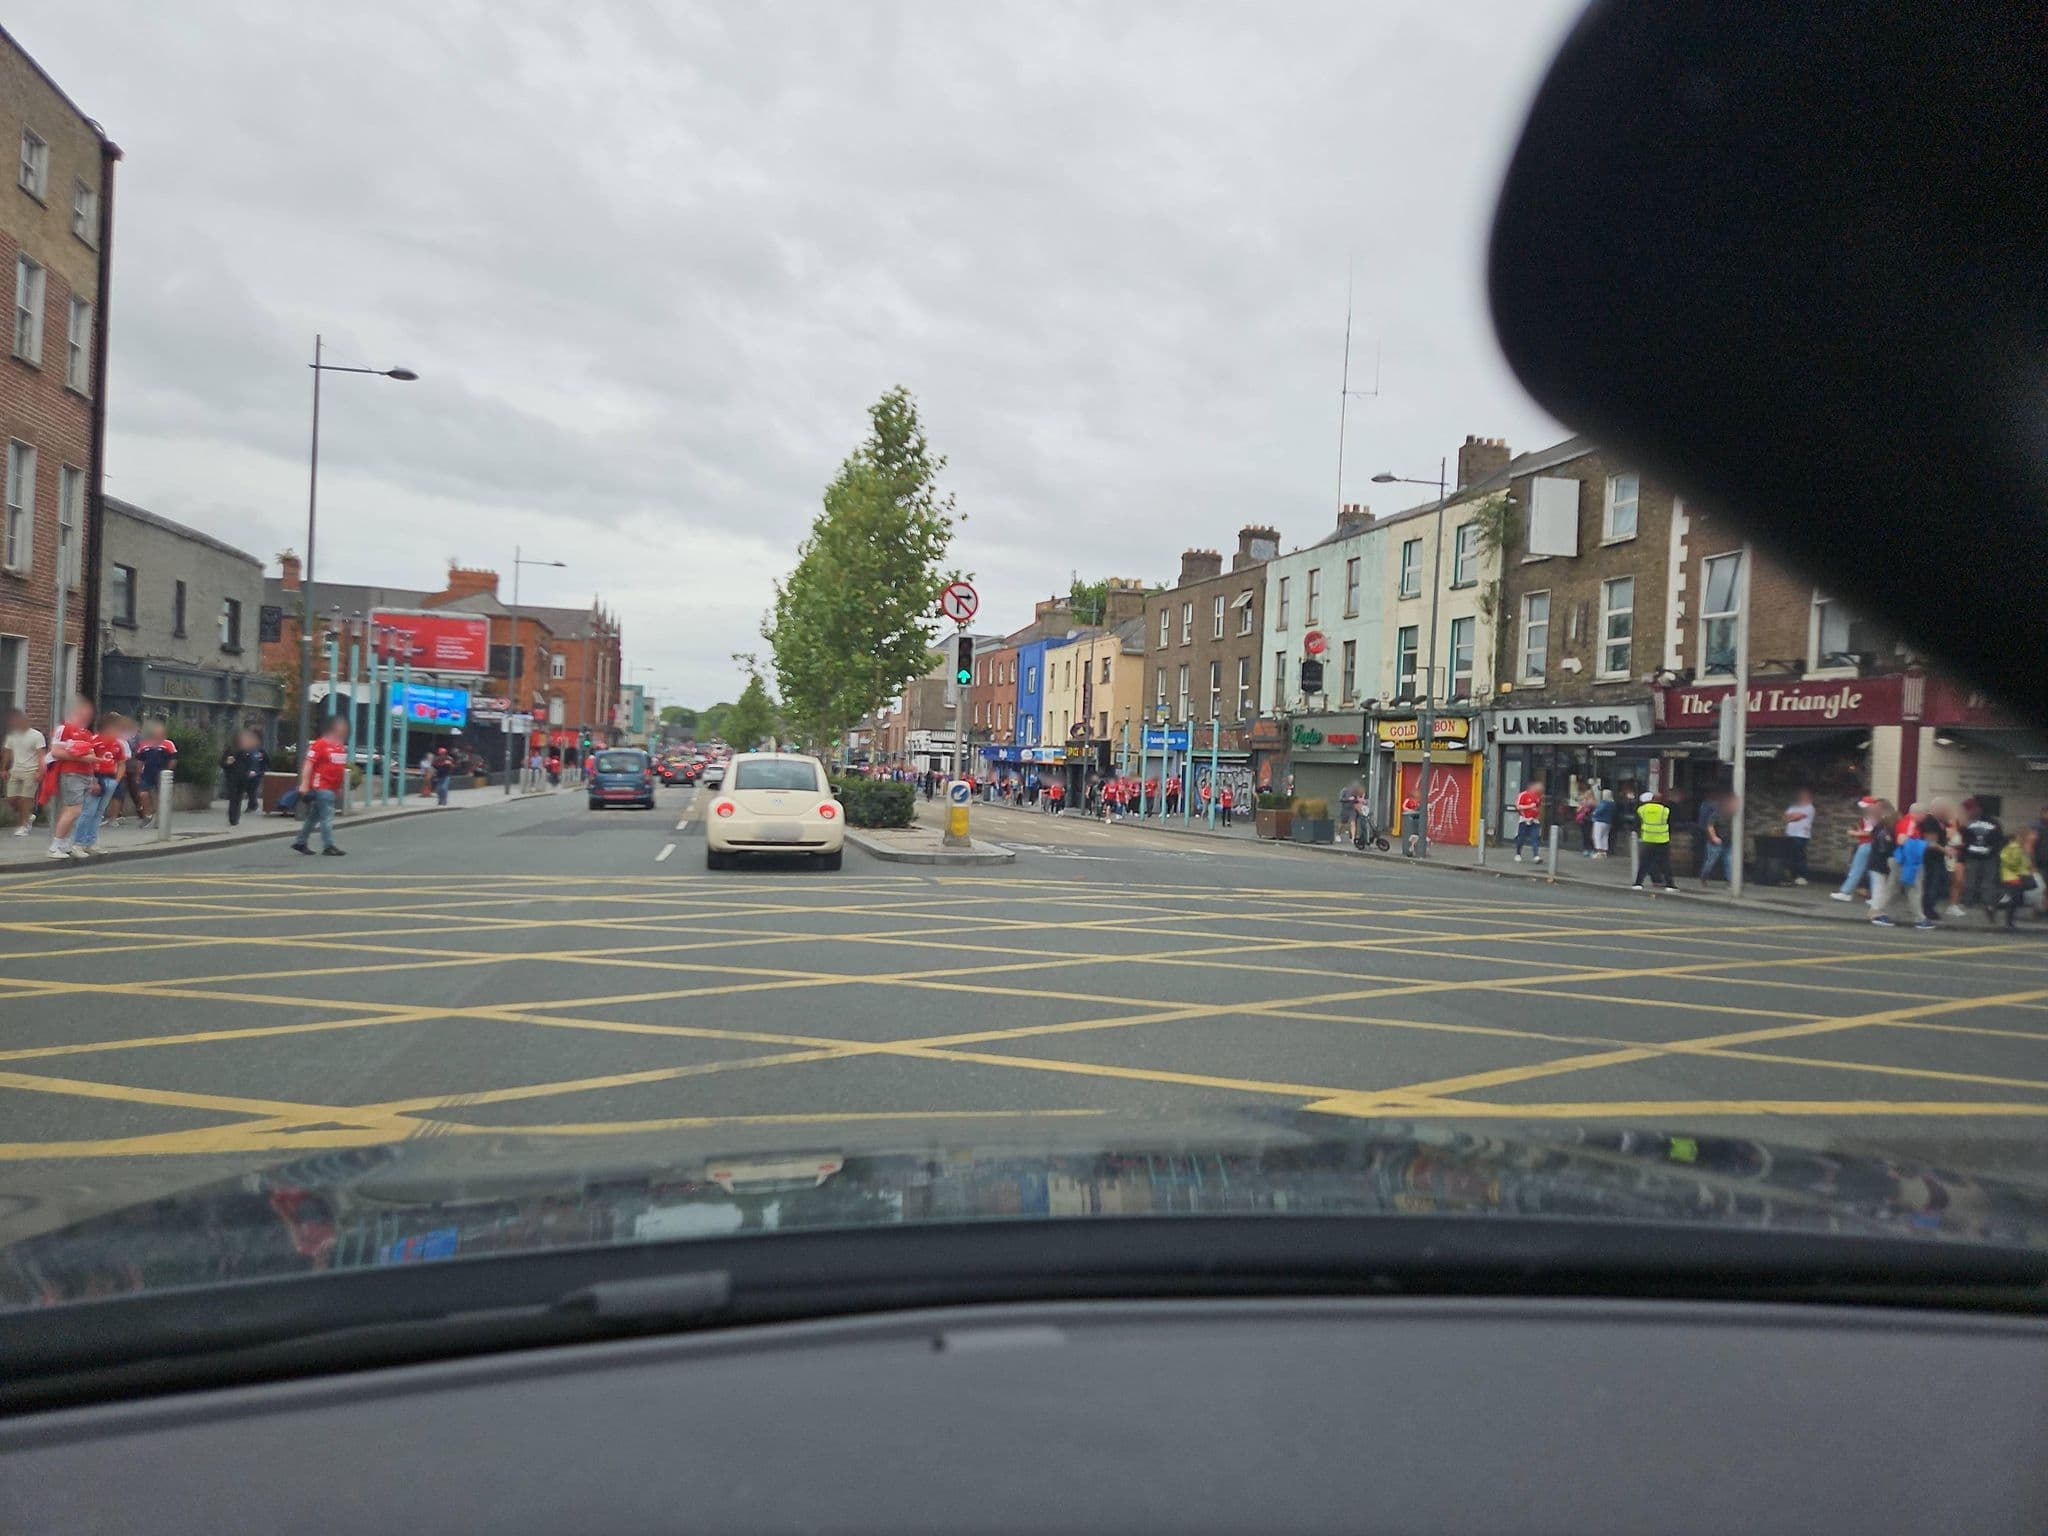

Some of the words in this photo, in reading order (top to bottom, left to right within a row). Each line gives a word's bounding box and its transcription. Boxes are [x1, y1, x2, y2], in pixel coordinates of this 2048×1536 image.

[1680, 694, 1713, 715] The
[1768, 686, 1863, 720] Triangle
[1390, 725, 1417, 737] GOLD
[1502, 717, 1523, 735] LA
[1527, 716, 1568, 735] Nails
[1573, 715, 1631, 735] Studio
